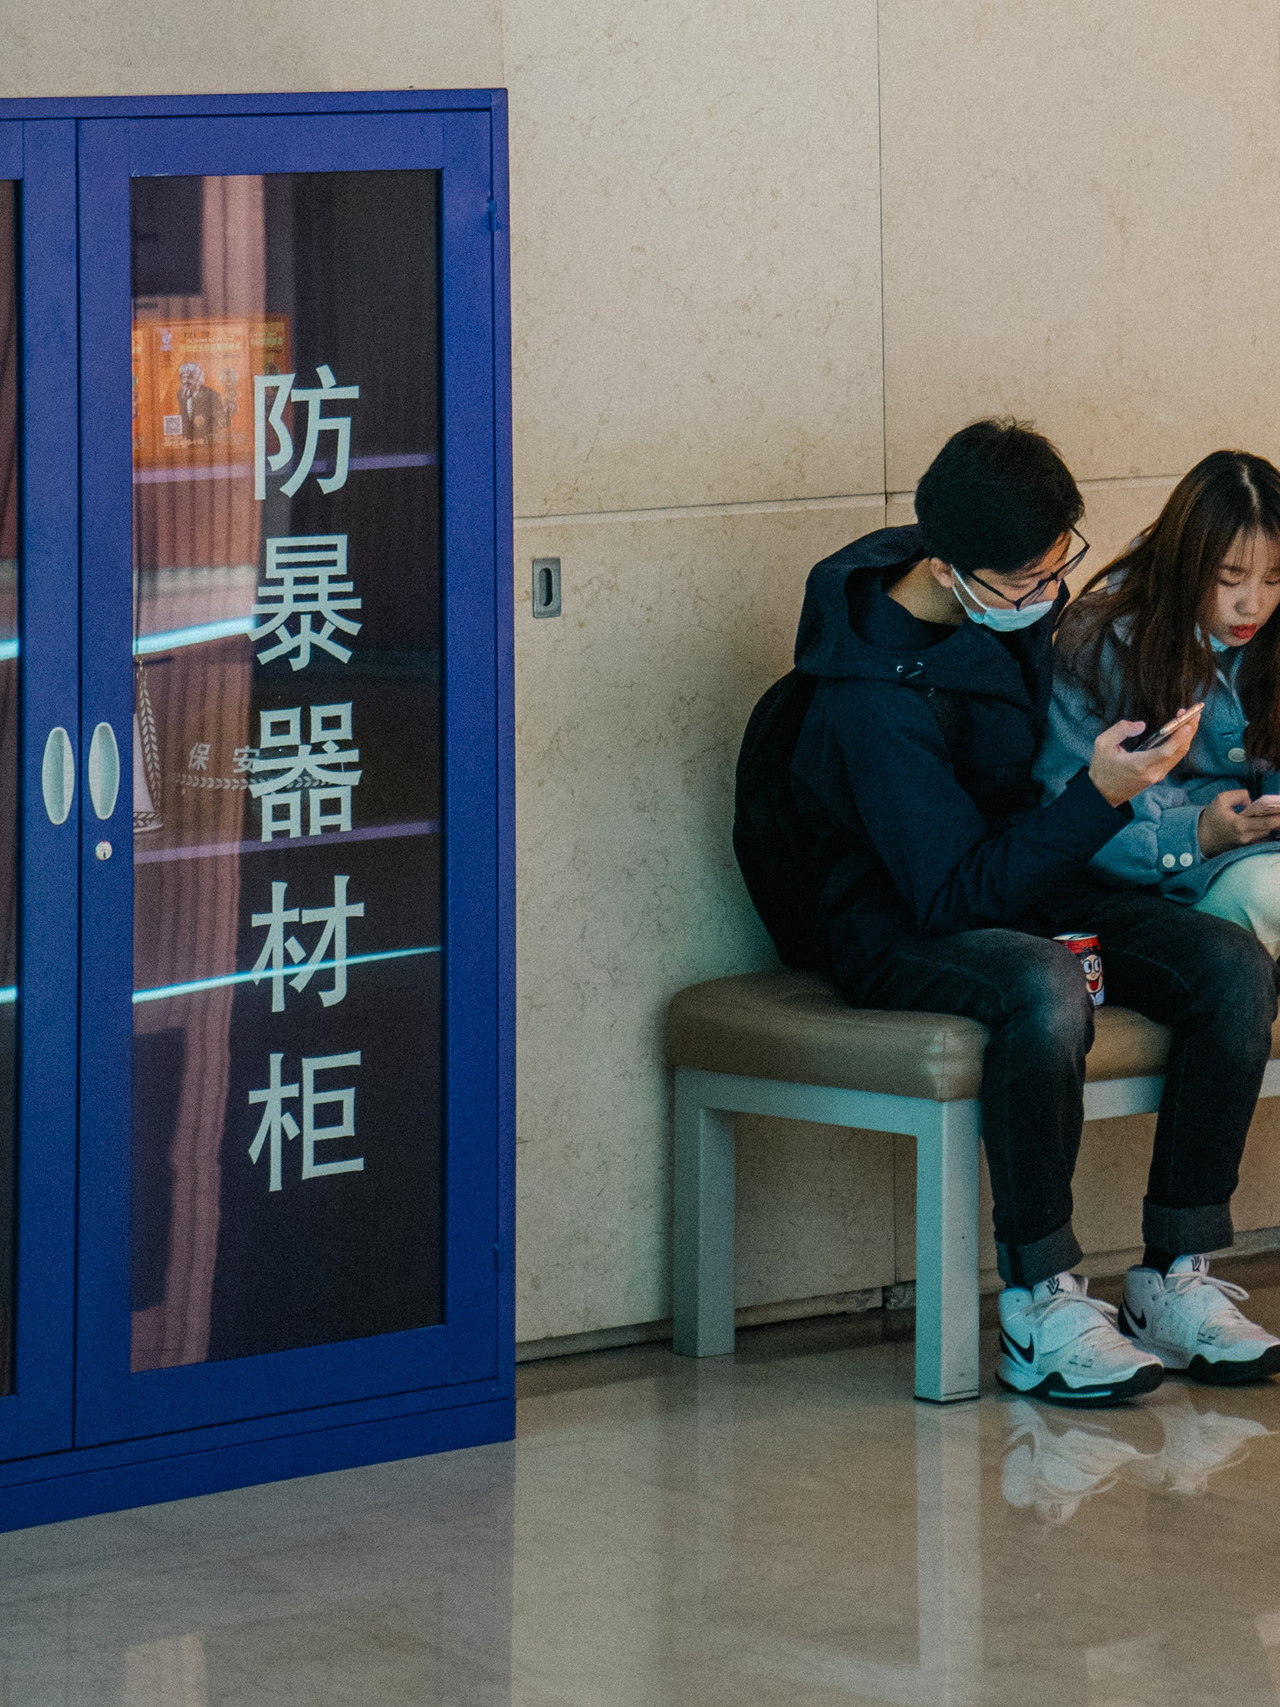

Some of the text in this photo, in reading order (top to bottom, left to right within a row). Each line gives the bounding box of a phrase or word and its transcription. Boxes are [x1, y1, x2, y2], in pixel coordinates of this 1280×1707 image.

[248, 364, 364, 1193] 防暴器材柜
